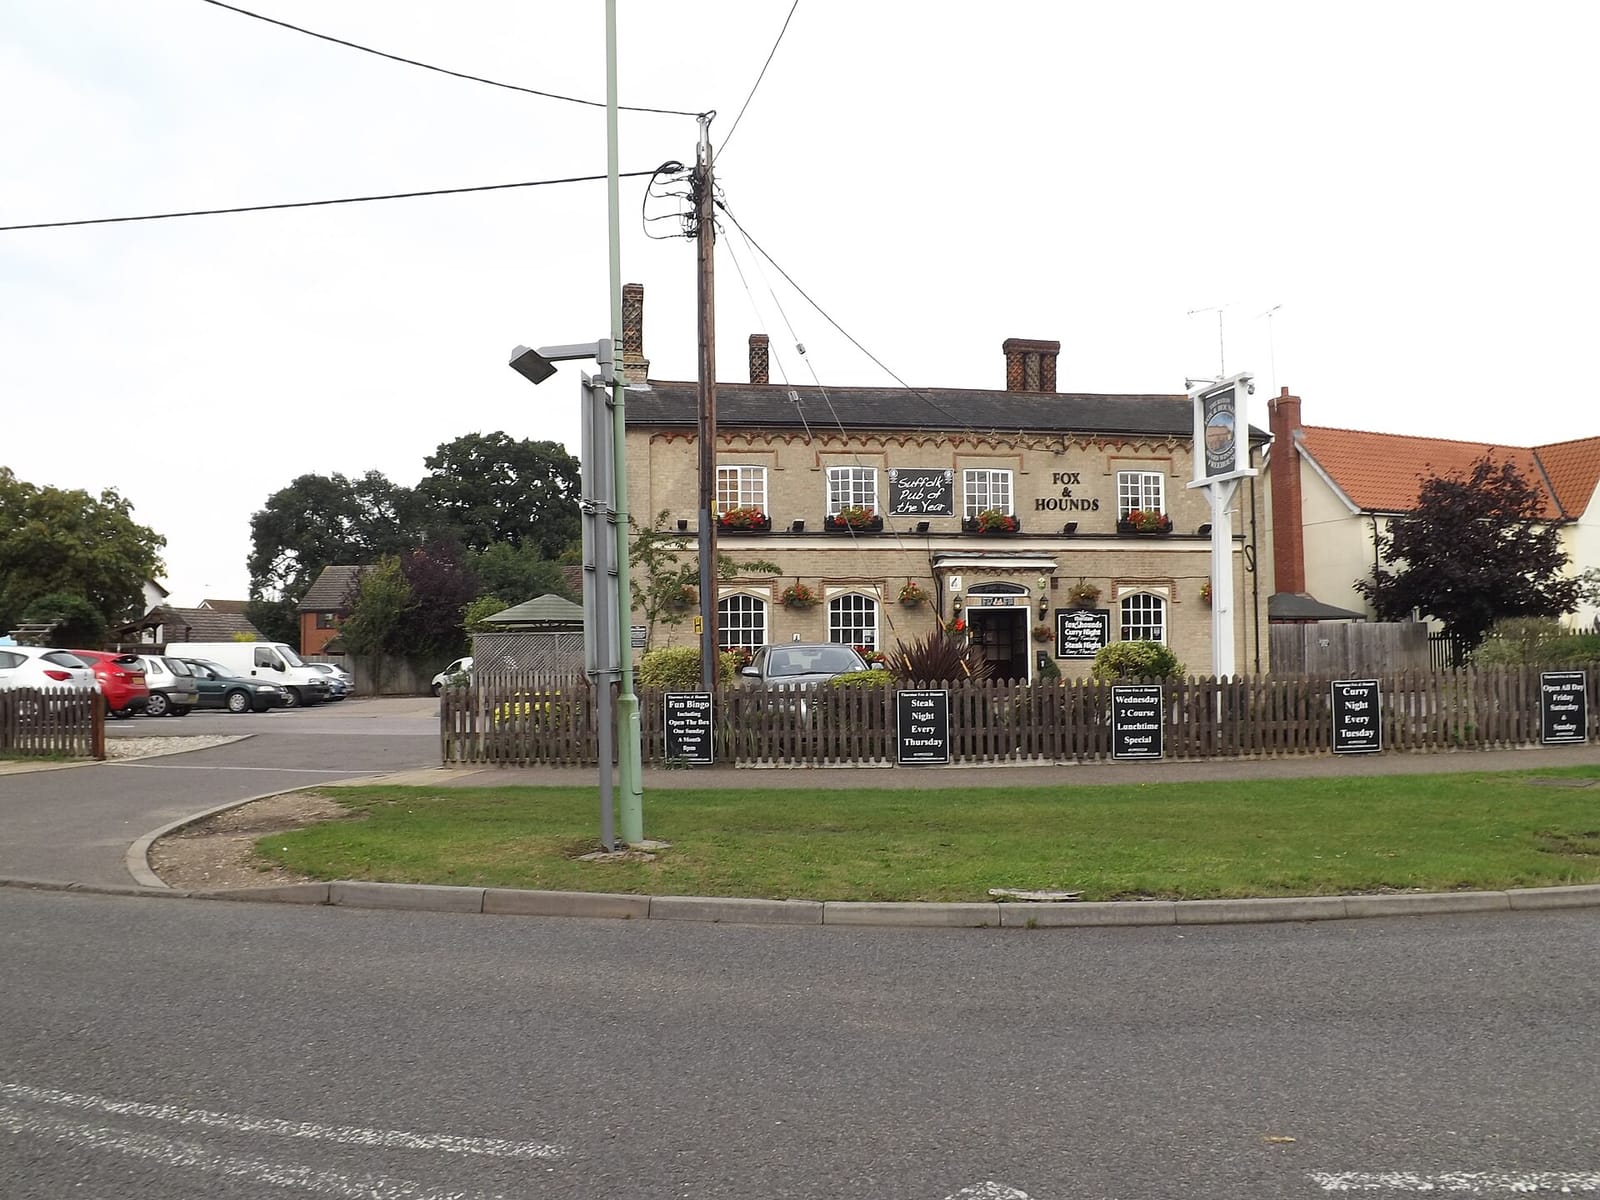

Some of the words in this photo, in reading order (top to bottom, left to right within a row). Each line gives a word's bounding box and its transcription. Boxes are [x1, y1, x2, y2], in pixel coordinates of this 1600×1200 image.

[897, 474, 945, 489] Suffolk
[1052, 472, 1080, 485] FOX
[900, 488, 924, 500] Pub
[927, 487, 945, 500] of
[1061, 487, 1073, 498] &
[896, 501, 918, 512] the
[921, 500, 945, 513] Year
[1034, 498, 1100, 511] HOUNDS
[1342, 687, 1369, 697] Curry
[1542, 684, 1561, 693] Open
[1571, 684, 1584, 692] Day
[911, 699, 935, 707] Steak
[1115, 695, 1159, 705] Wednesday
[1552, 694, 1574, 702] Friday
[686, 700, 710, 710] Bingo
[1344, 701, 1368, 711] Night
[911, 712, 935, 722] Night
[1120, 709, 1126, 717] 2
[1127, 709, 1155, 717] Course
[668, 719, 685, 727] Open
[1344, 715, 1370, 725] Every
[911, 725, 936, 735] Every
[1117, 722, 1159, 731] Lunchtime
[1340, 728, 1375, 738] Tuesday
[903, 738, 944, 748] Thursday
[1123, 736, 1152, 746] Special
